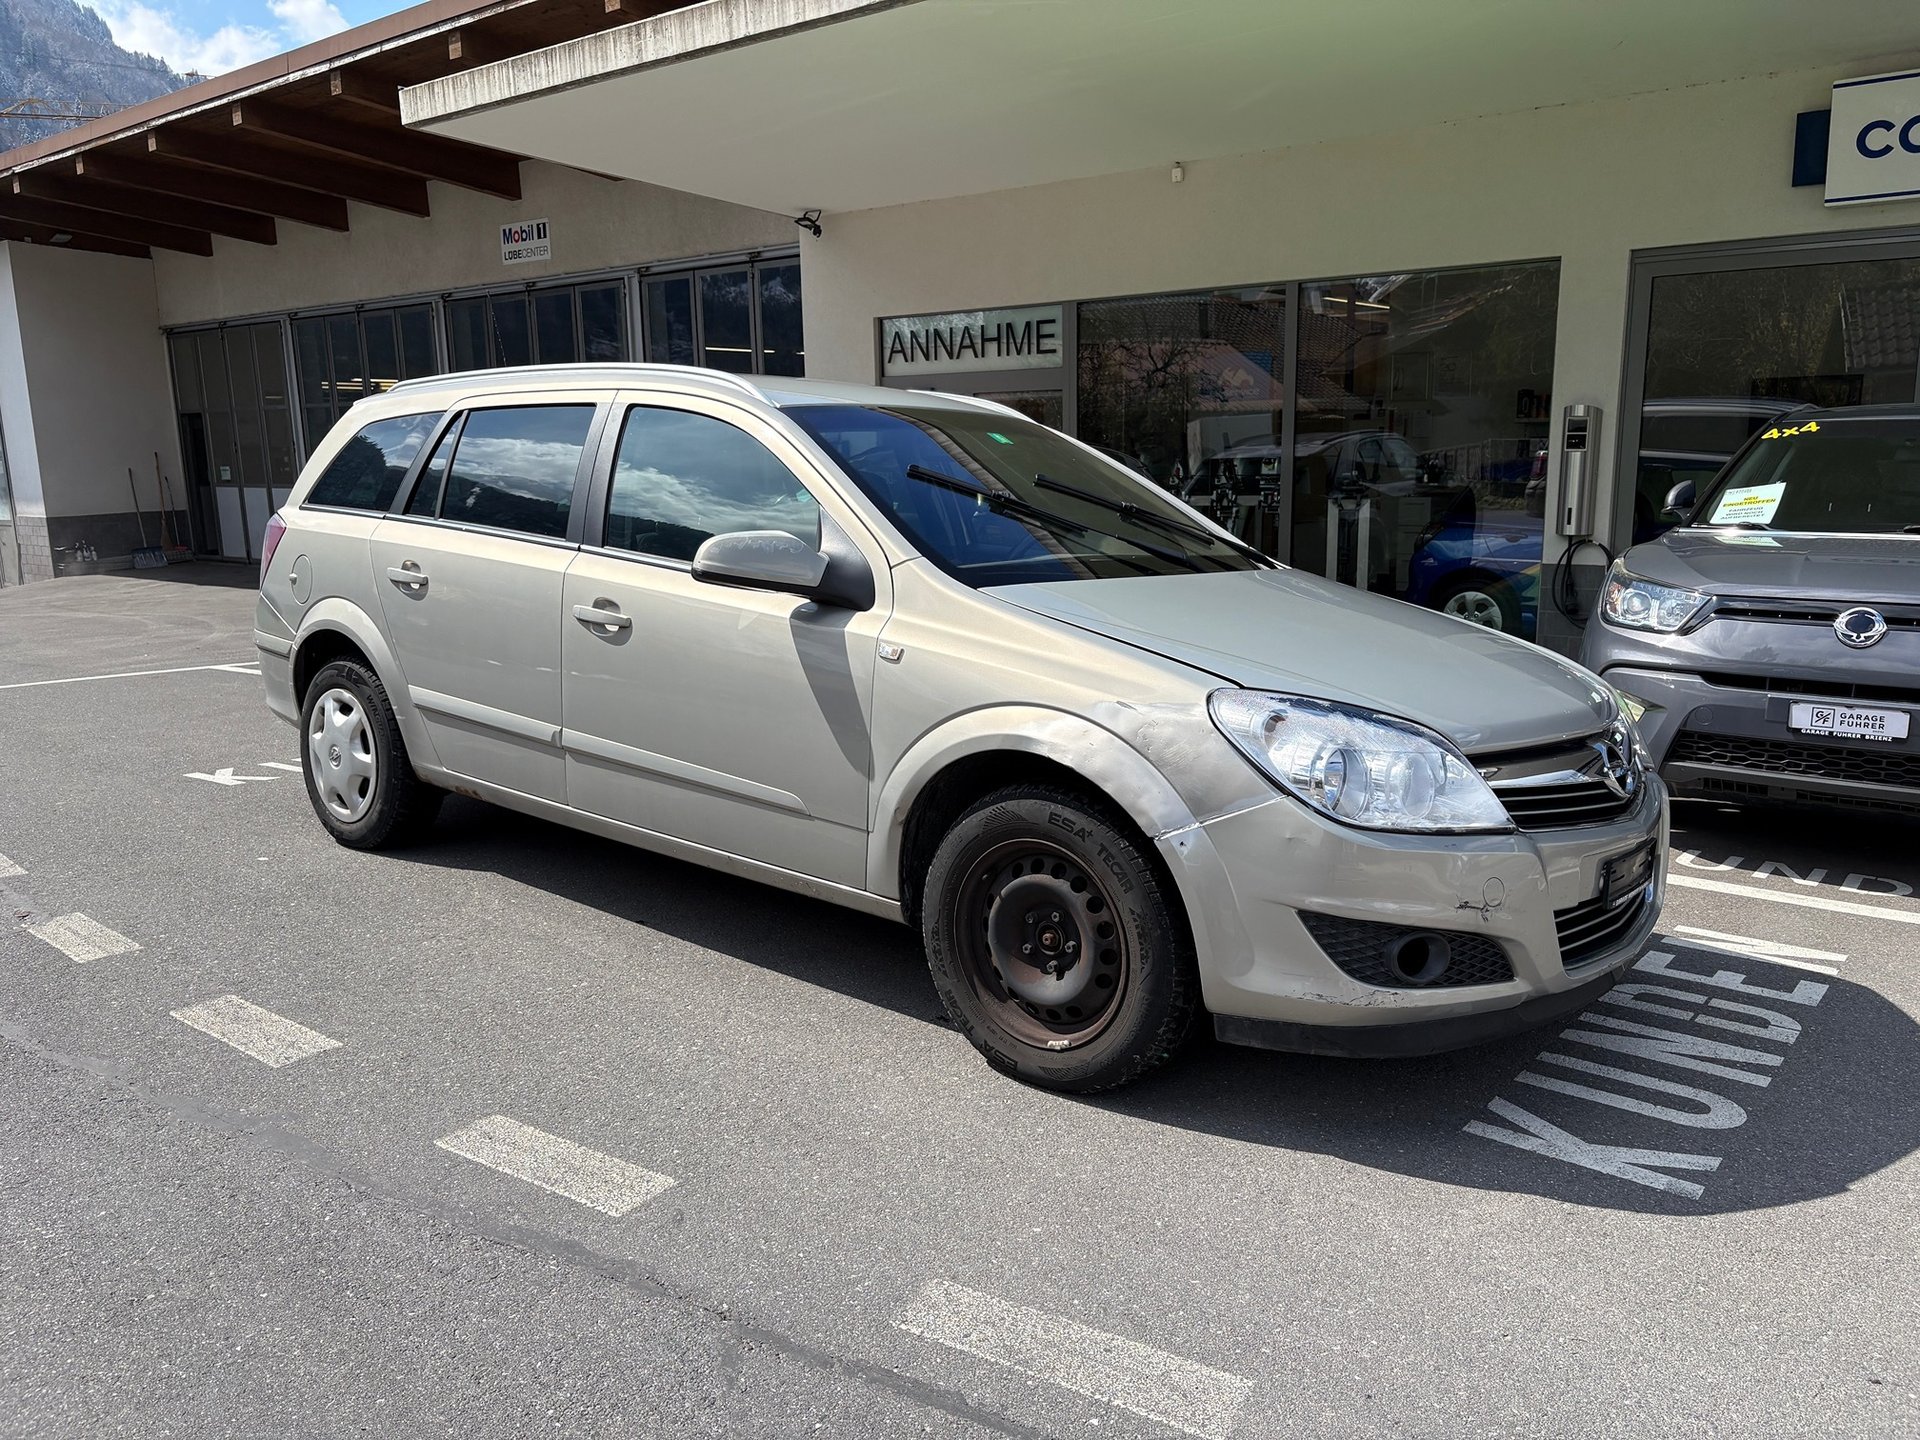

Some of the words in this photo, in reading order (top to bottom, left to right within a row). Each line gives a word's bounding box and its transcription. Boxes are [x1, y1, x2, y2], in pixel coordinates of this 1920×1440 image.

[502, 224, 534, 245] Mobil
[536, 222, 547, 239] 1
[887, 319, 1058, 364] ANNAHME
[1761, 421, 1820, 439] 4x4
[1840, 713, 1885, 722] GARAGE
[1840, 720, 1885, 730] FUHRER
[1833, 731, 1861, 739] FUHRER
[1096, 843, 1135, 894] TECAR
[1462, 925, 1848, 1200] KUNDEN
